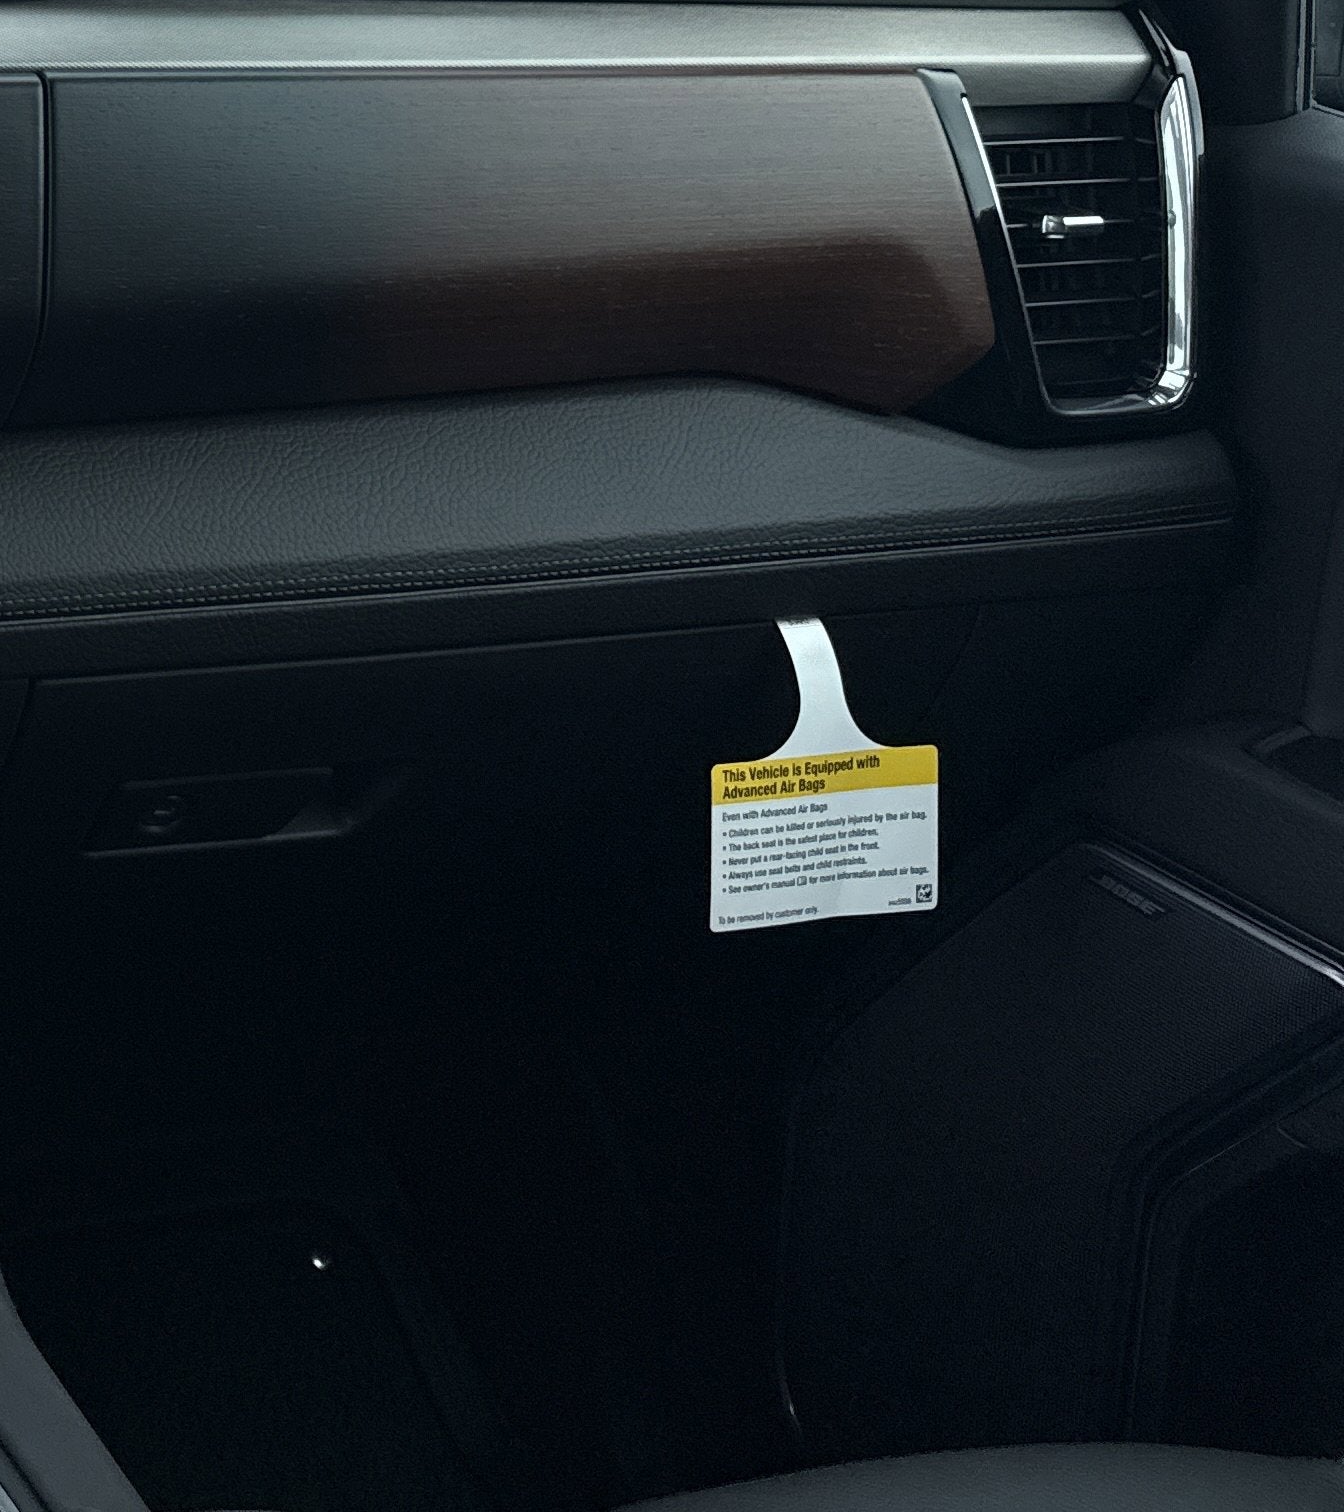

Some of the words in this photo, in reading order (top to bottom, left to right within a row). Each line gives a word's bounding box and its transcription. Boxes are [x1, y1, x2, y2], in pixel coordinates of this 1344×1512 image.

[722, 768, 746, 783] This
[749, 765, 789, 781] Vehicle
[804, 757, 854, 777] Equipped
[856, 755, 880, 768] with
[722, 782, 777, 800] Advanced
[780, 780, 796, 794] Air
[798, 778, 826, 794] Bags
[760, 806, 796, 818] Advanced
[798, 804, 808, 814] Air
[810, 803, 828, 813] Bags
[728, 828, 759, 838] Children
[816, 817, 846, 828] seriously
[729, 843, 742, 851] The
[743, 841, 760, 850] back
[728, 871, 753, 880] Always
[728, 885, 742, 894] See
[837, 870, 876, 880] information
